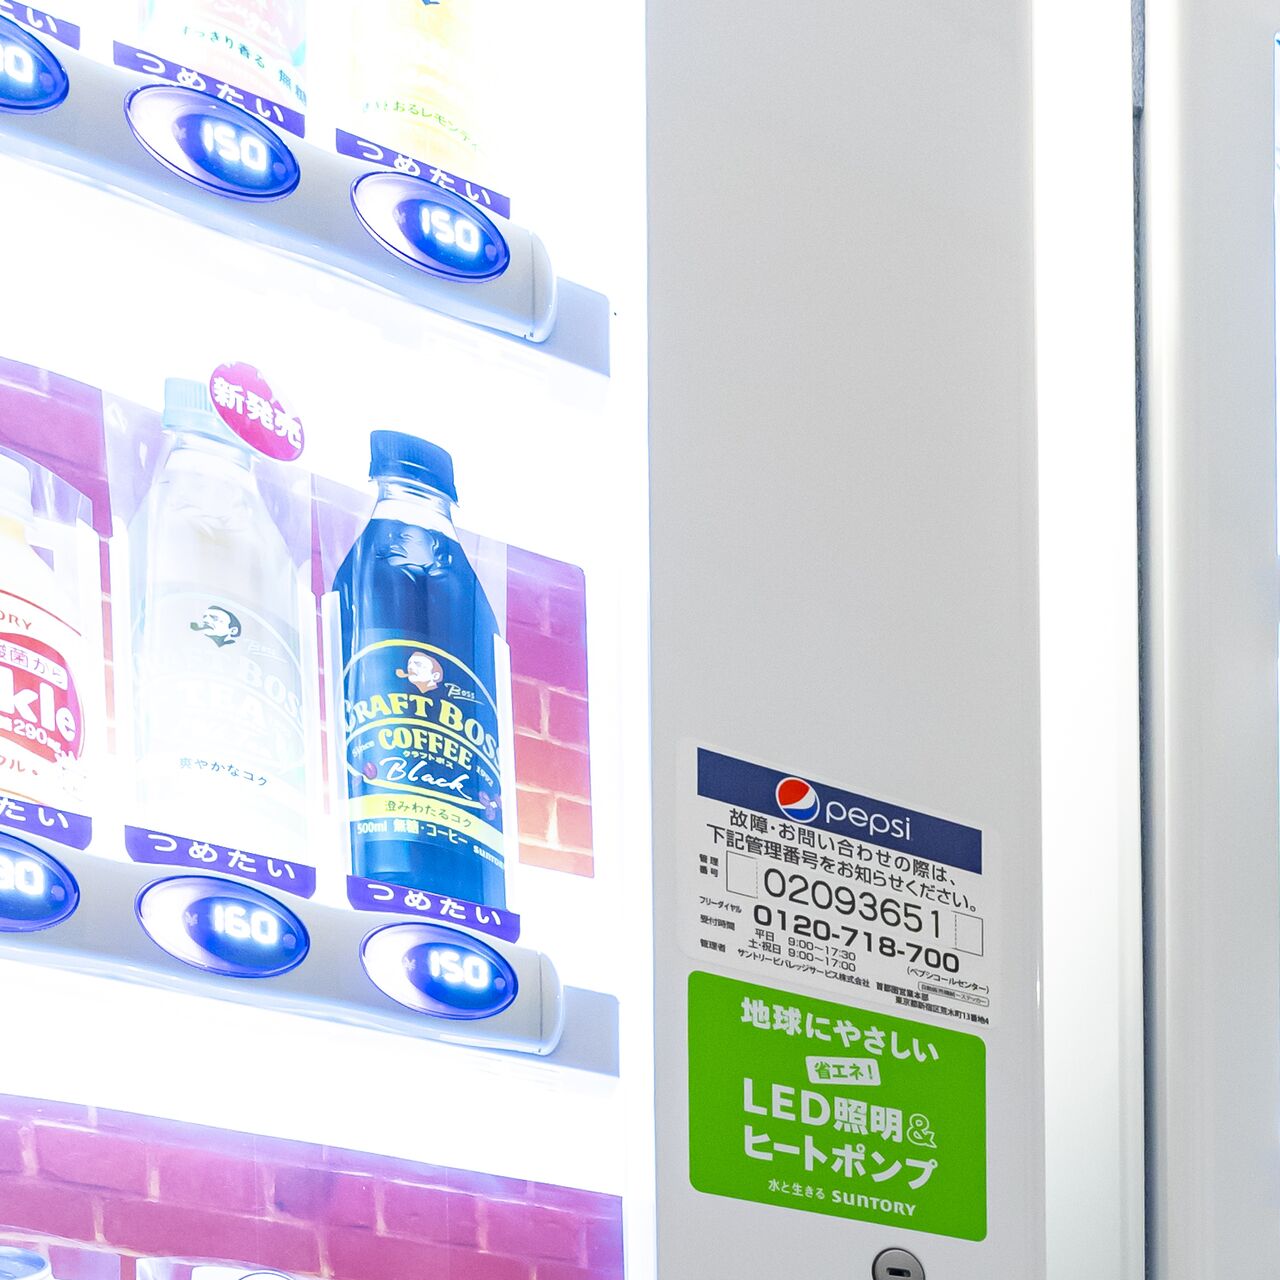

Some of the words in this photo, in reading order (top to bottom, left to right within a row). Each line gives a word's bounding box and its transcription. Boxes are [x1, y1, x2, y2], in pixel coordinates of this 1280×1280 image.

[136, 52, 284, 123] つめたい
[203, 121, 268, 172] 150
[356, 140, 491, 206] つめたい
[421, 207, 480, 253] 150
[211, 375, 302, 450] 新発売
[179, 756, 268, 788] 爽やかなコク
[378, 727, 474, 771] COFFEE
[380, 757, 473, 801] Black
[385, 800, 472, 829] 澄みわたるコク
[826, 801, 912, 841] pepsi
[147, 833, 295, 882] つめたい
[707, 824, 976, 912] 下記管理番号をお知らせください。
[729, 808, 957, 886] 故障・お問い合わせの際は、
[214, 904, 279, 945] 160
[368, 882, 502, 927] つめたい
[764, 867, 940, 939] 02093651
[754, 904, 960, 974] 0120-718-700
[755, 928, 775, 943] 平日
[428, 949, 490, 989] 150
[741, 996, 940, 1063] 地球にやさしい
[744, 1124, 939, 1190] ヒートポンプ
[768, 1178, 825, 1200] 水と生きる
[832, 1189, 917, 1218] SUNTORY
